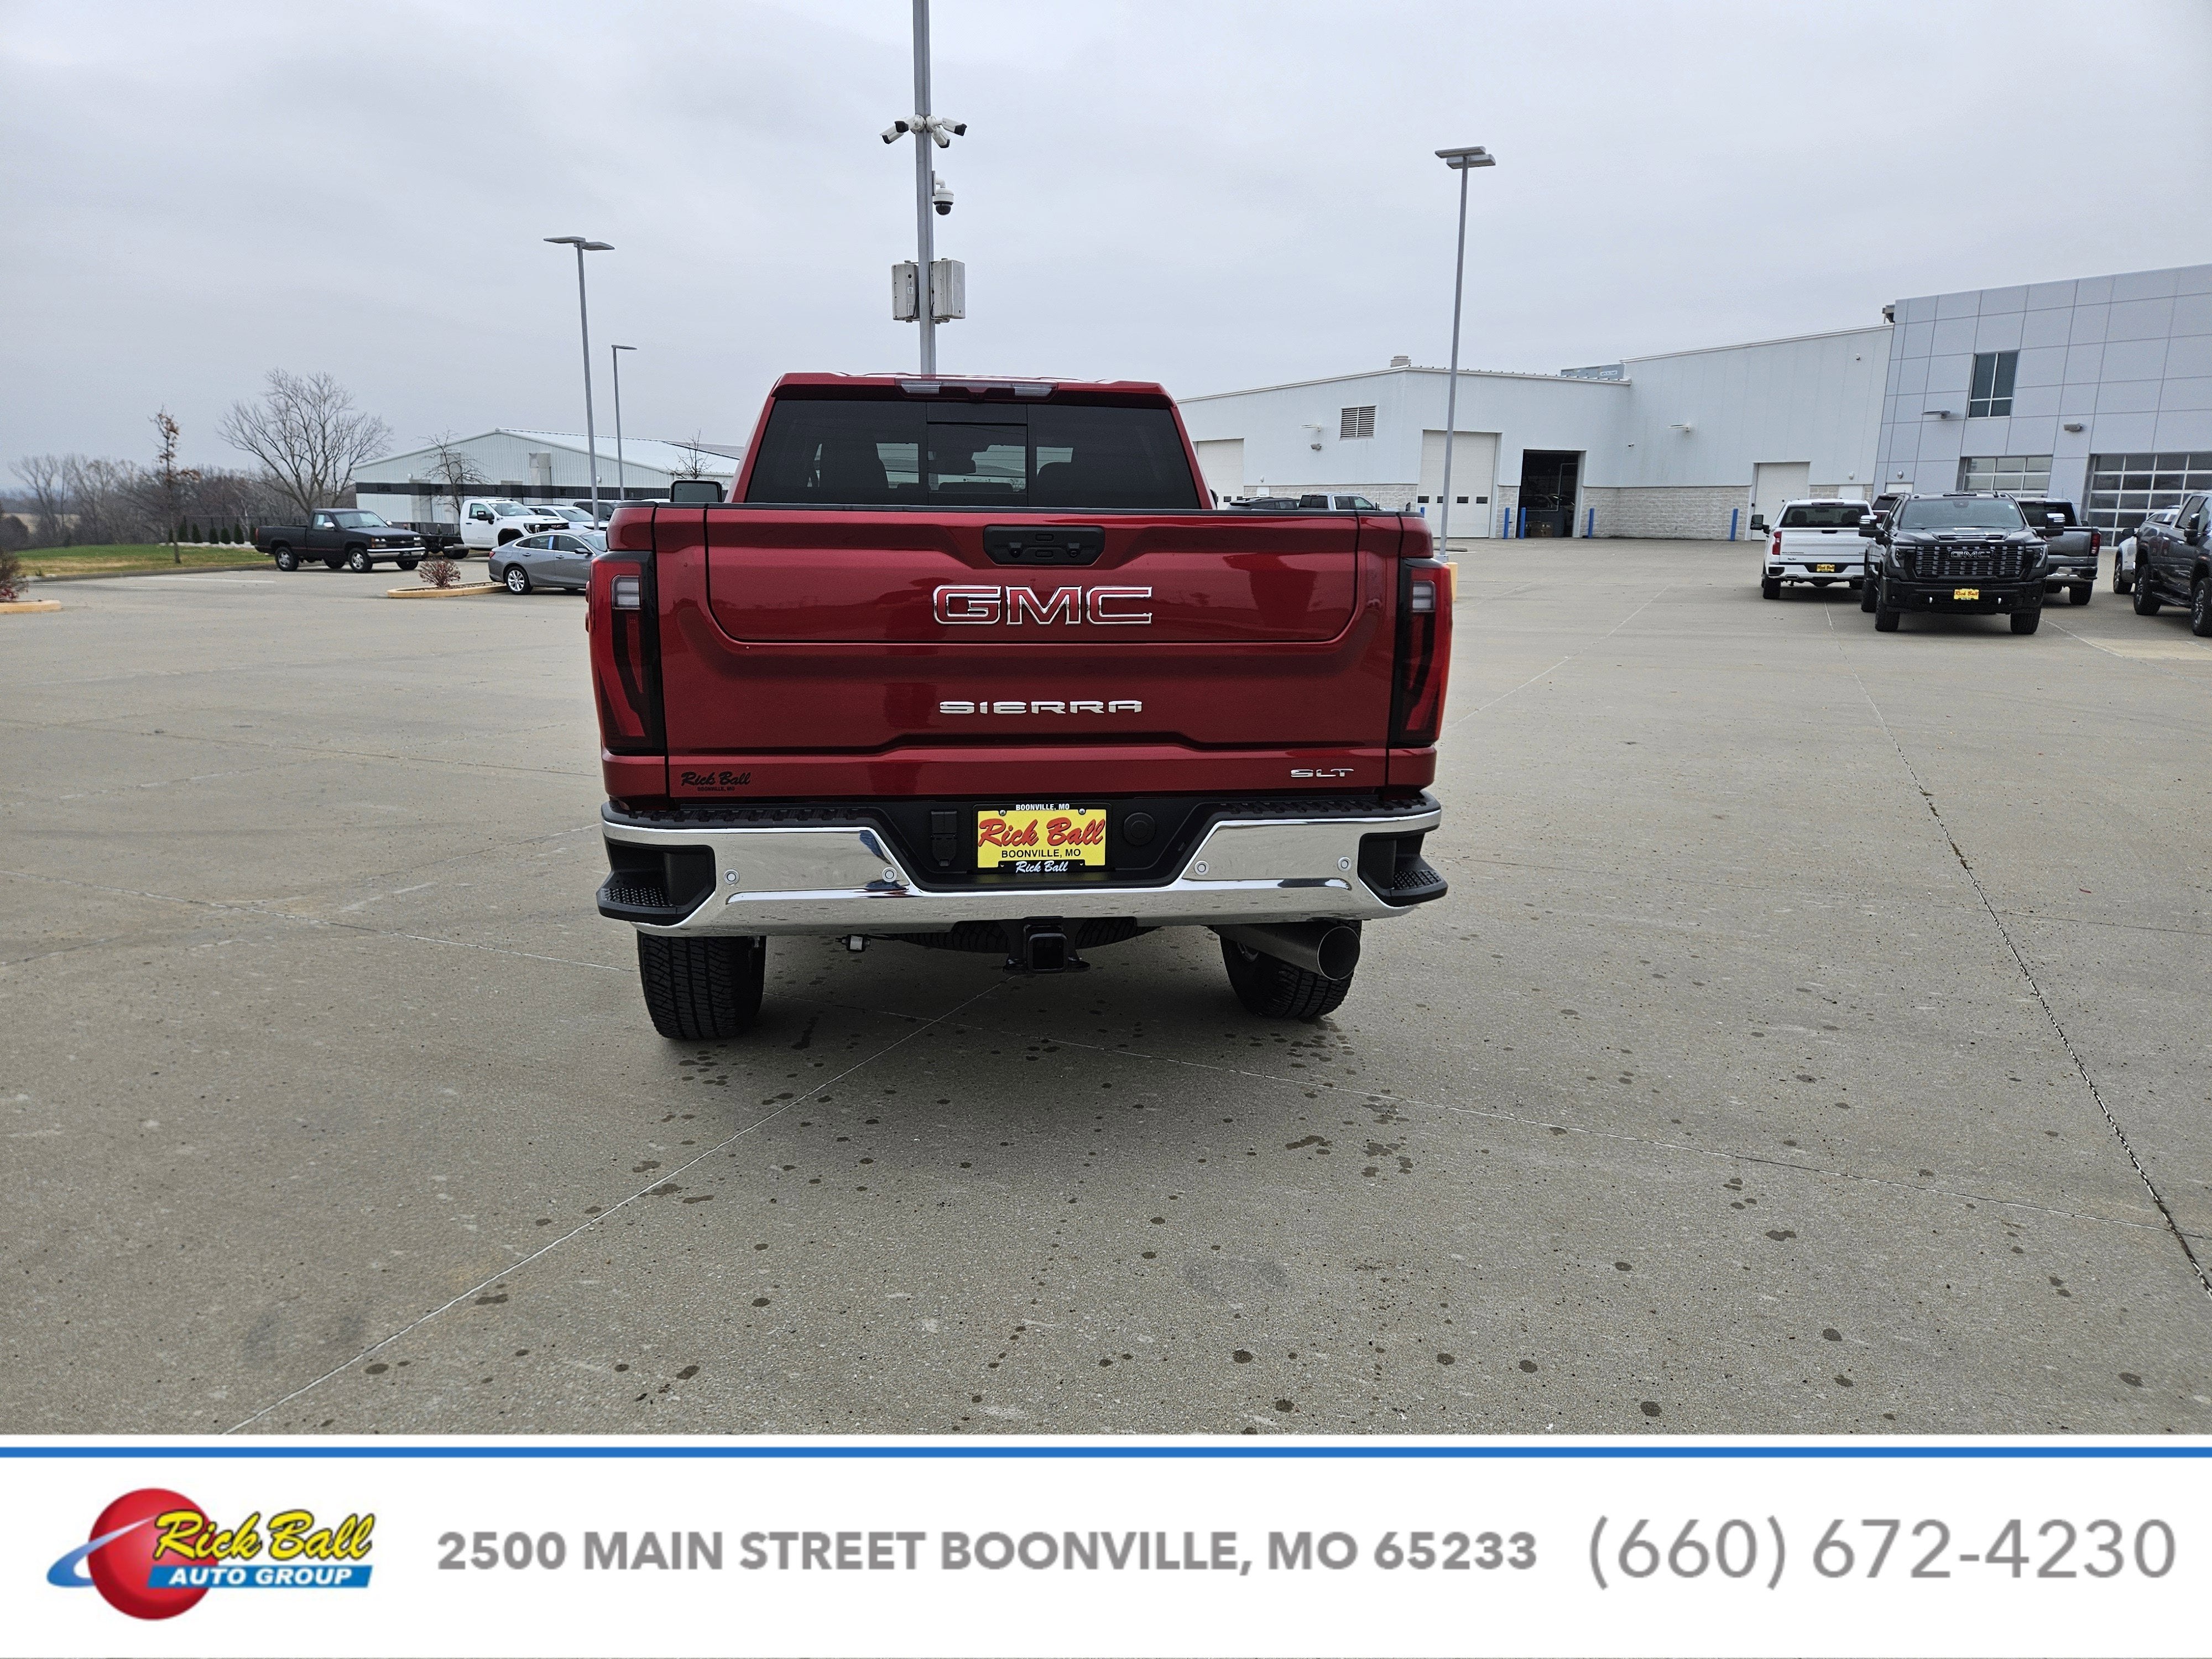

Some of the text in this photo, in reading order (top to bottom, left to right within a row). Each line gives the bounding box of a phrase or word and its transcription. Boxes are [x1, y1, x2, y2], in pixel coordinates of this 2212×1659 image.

[933, 585, 1153, 625] GMC
[940, 701, 1142, 714] SIERRA
[681, 771, 751, 786] Rick Ball
[1290, 768, 1354, 778] SLT
[978, 817, 1105, 847] Rick Ball
[1001, 849, 1062, 858] BOONVILLE,
[1015, 860, 1068, 873] Rick Ball
